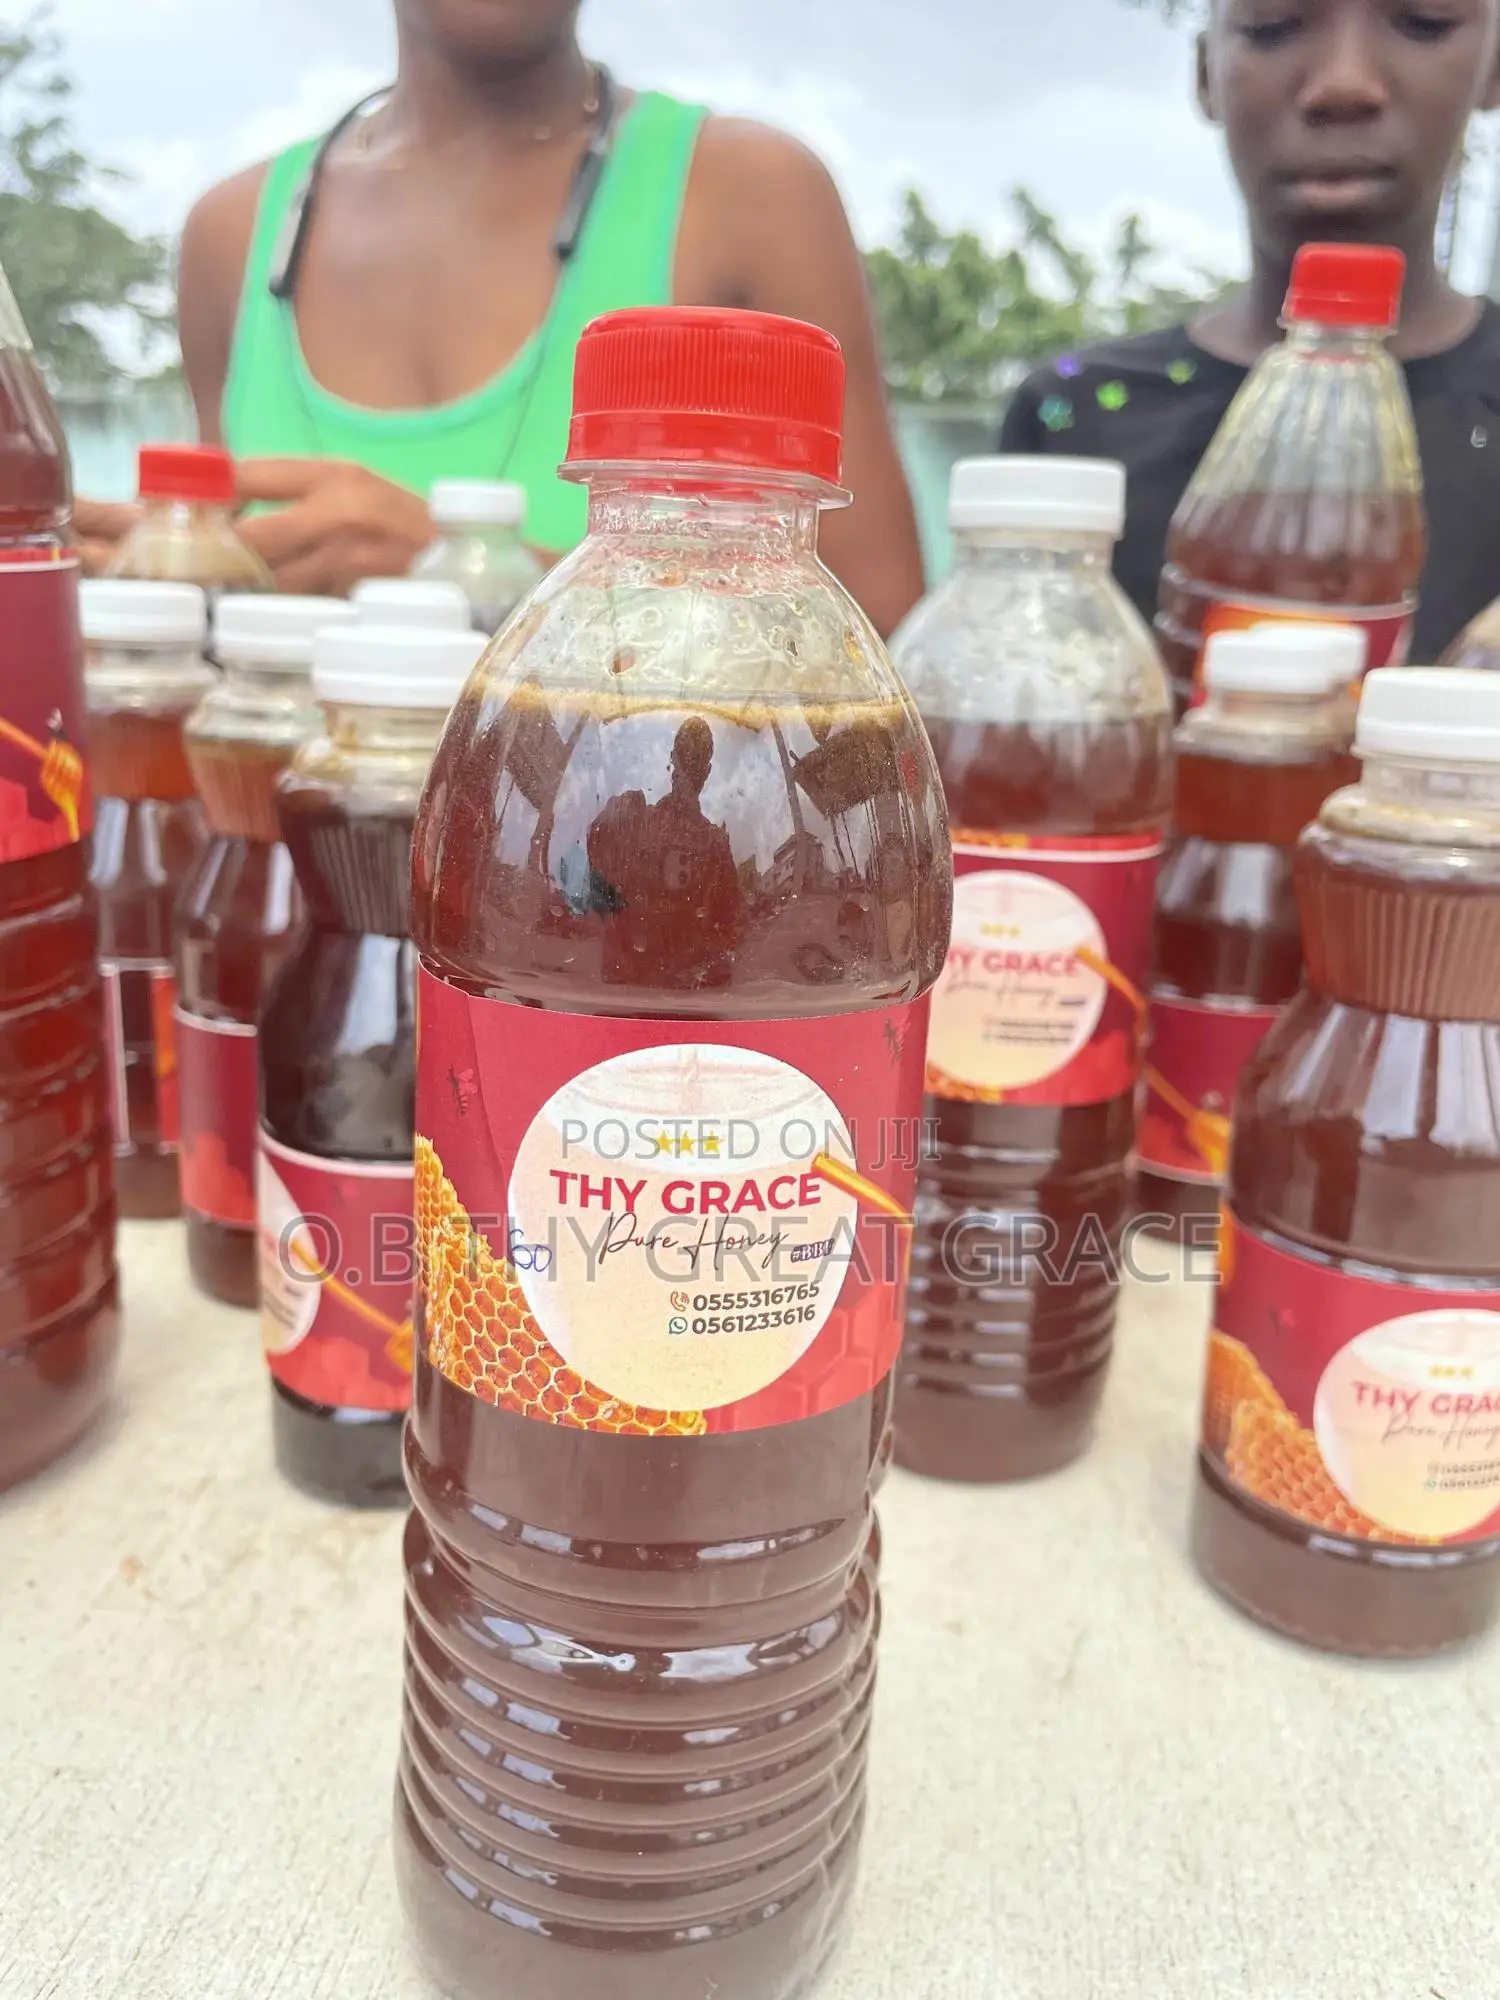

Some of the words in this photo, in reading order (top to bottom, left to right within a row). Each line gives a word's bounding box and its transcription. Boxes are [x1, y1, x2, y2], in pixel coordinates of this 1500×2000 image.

[983, 950, 1078, 976] GRACE
[548, 1169, 648, 1213] THY
[661, 1172, 822, 1215] GRACE
[598, 1211, 680, 1265] Pure
[683, 1213, 790, 1271] Honey
[692, 1279, 820, 1312] 0555316765
[691, 1303, 816, 1335] 0561233616
[1352, 1379, 1422, 1414] THY
